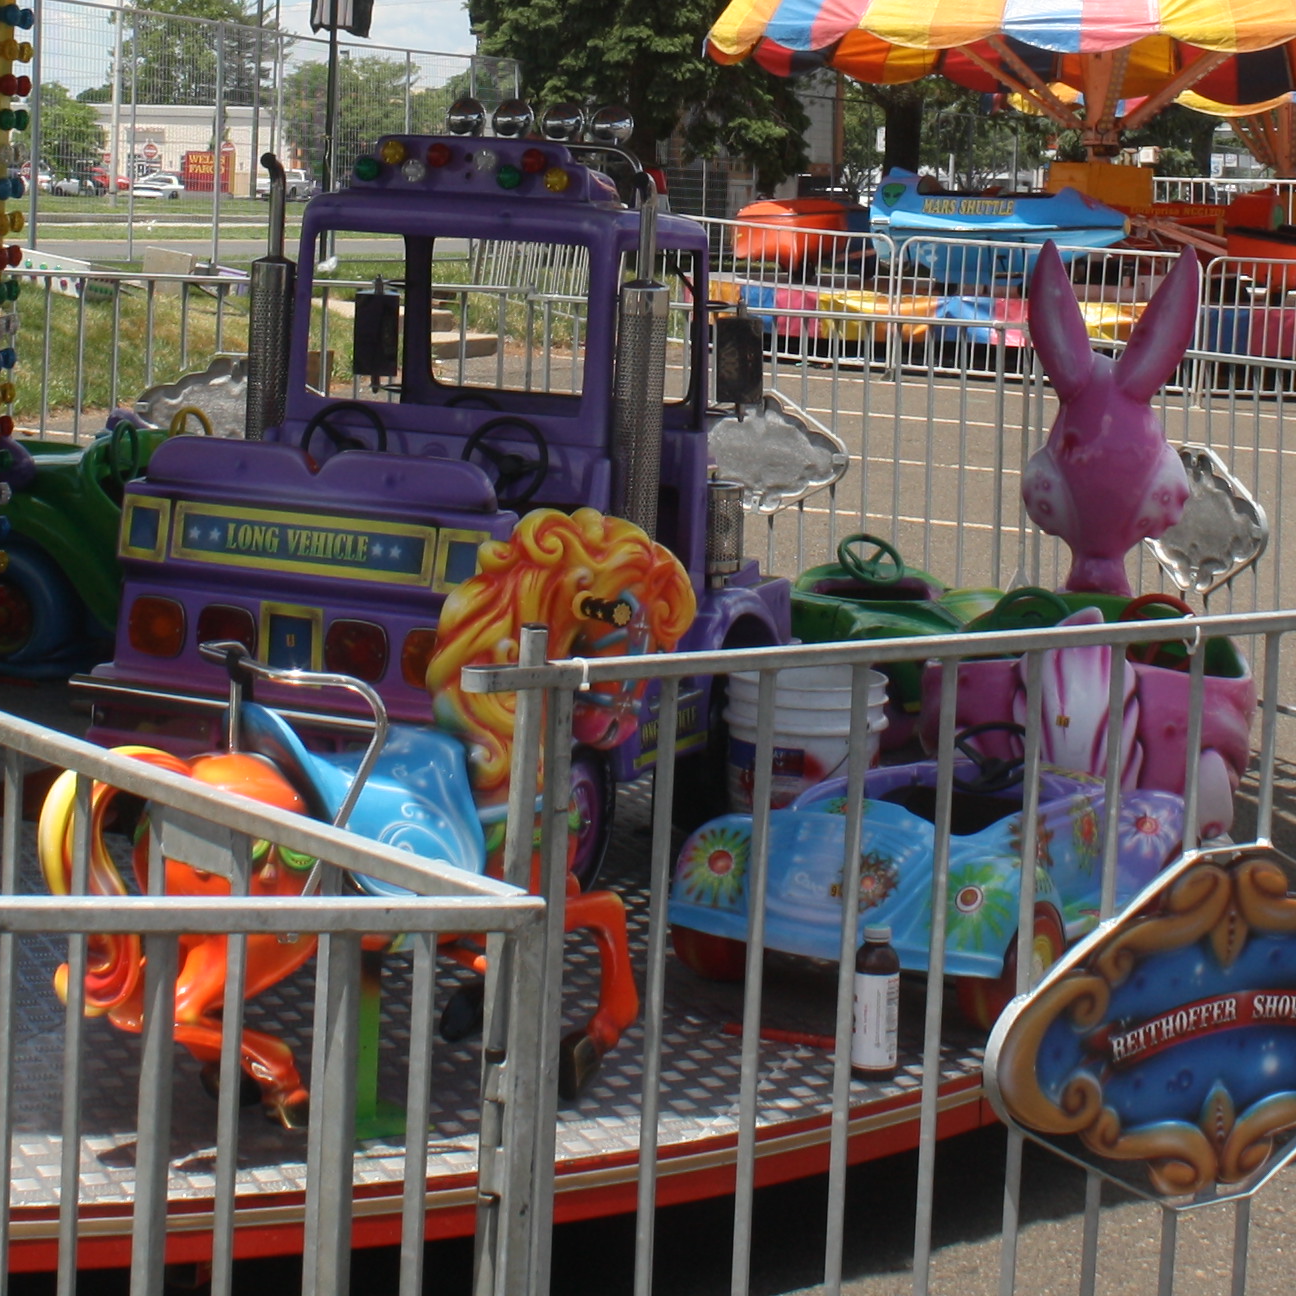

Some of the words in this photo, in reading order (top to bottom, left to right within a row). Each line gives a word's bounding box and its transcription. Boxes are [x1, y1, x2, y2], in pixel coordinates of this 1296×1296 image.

[923, 197, 956, 215] MARS
[959, 197, 1015, 216] SHUTTLE
[226, 522, 280, 553] LONG
[287, 528, 369, 562] VEHICLE
[1112, 998, 1237, 1063] REITHOFFER
